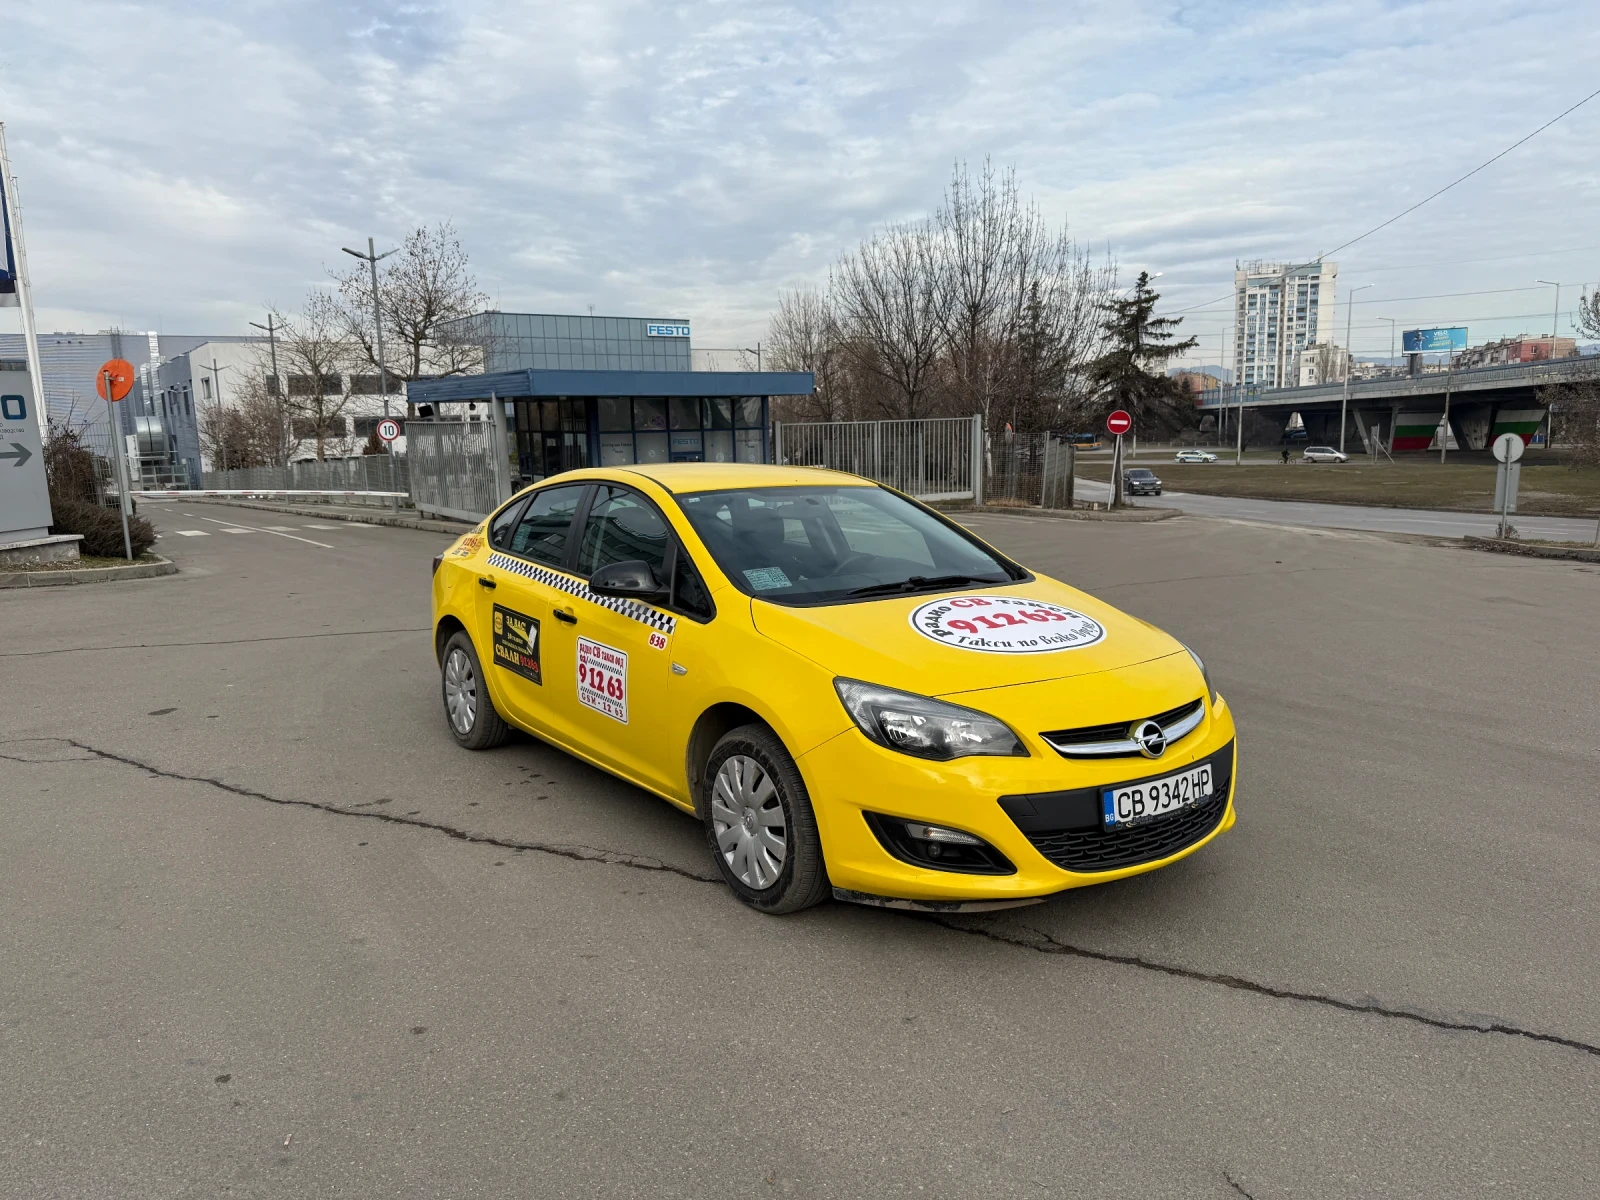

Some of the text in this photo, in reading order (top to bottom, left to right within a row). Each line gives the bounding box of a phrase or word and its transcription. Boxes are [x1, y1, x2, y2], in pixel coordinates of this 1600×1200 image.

[648, 325, 690, 336] FESTO
[383, 425, 395, 436] 10
[946, 609, 1067, 634] 91263
[649, 633, 666, 649] 838
[1016, 639, 1038, 647] по
[581, 692, 597, 706] GSM
[1148, 776, 1190, 812] 9342
[1105, 813, 1115, 823] BG
